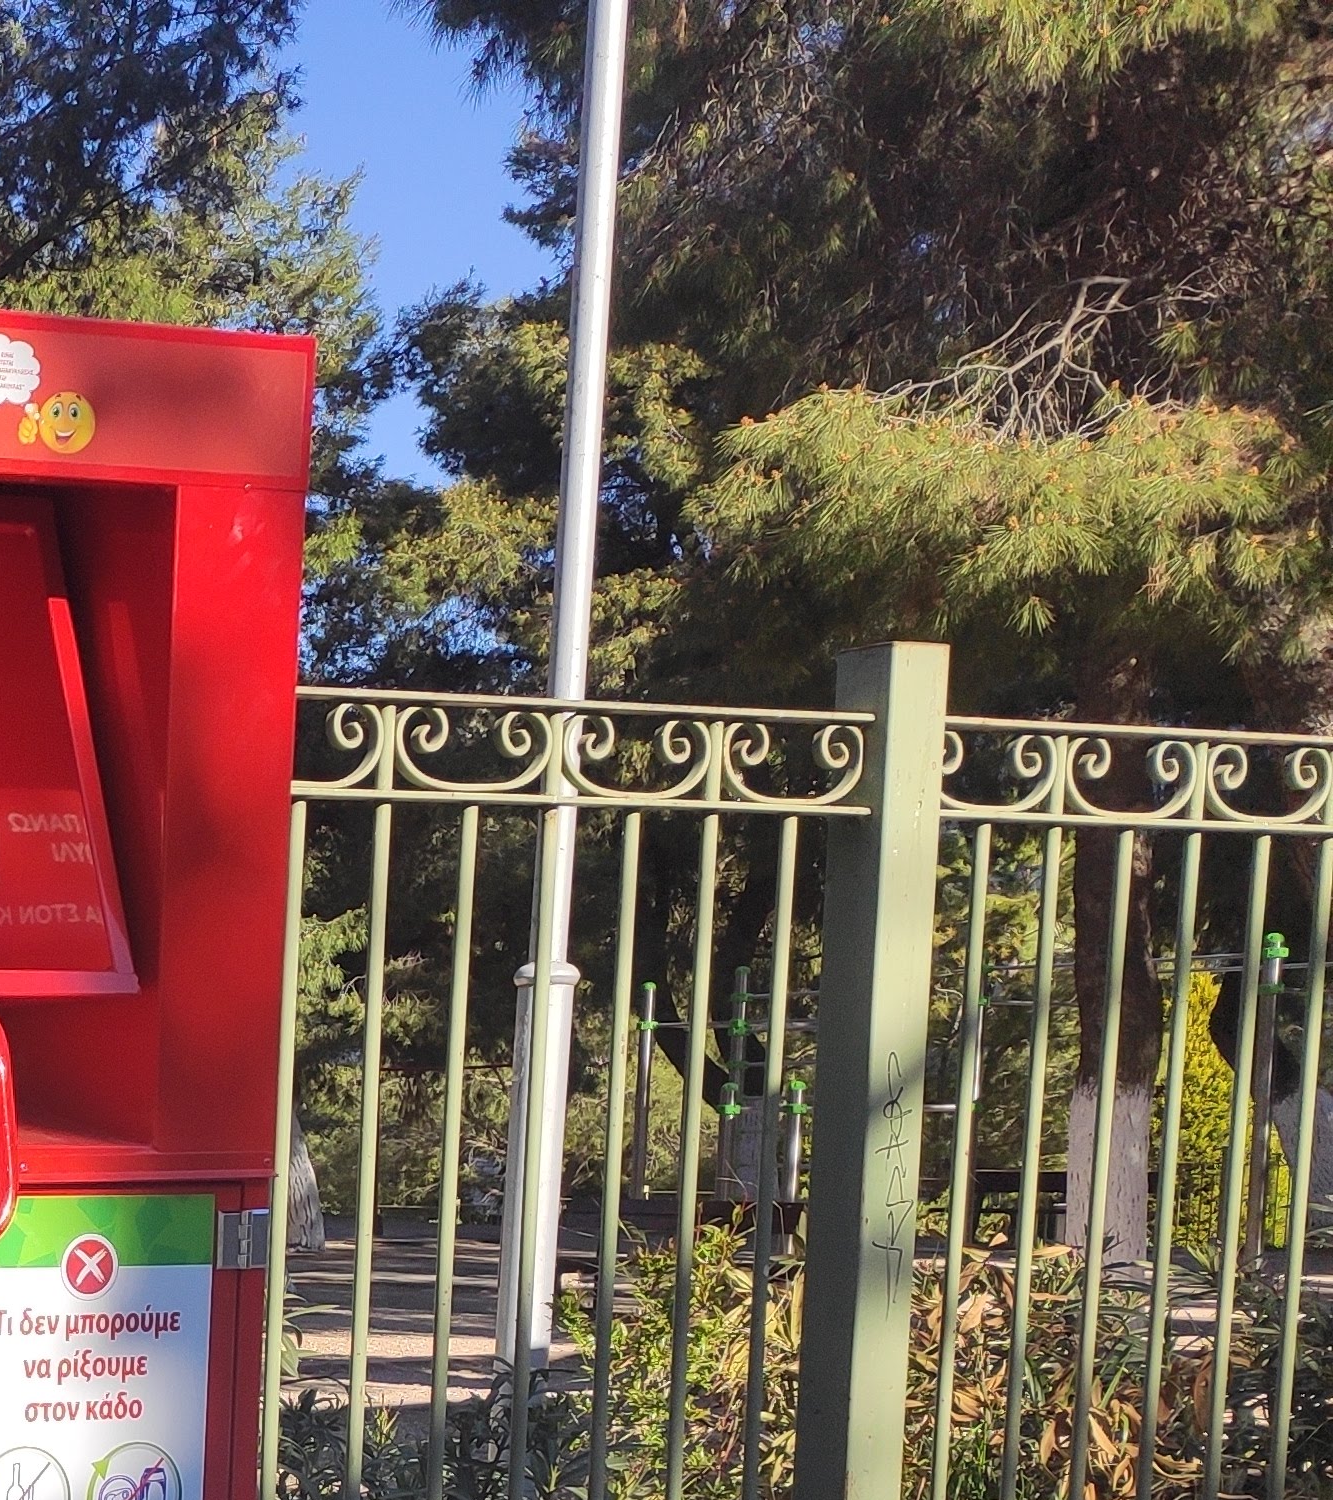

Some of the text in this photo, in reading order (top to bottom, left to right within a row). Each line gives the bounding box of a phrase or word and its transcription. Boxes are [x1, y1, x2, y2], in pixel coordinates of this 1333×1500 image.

[19, 1307, 60, 1336] δεν
[65, 1304, 181, 1342] μπορούμε
[23, 1349, 149, 1386] να ρίξουμε
[24, 1391, 143, 1423] στον κάδο
